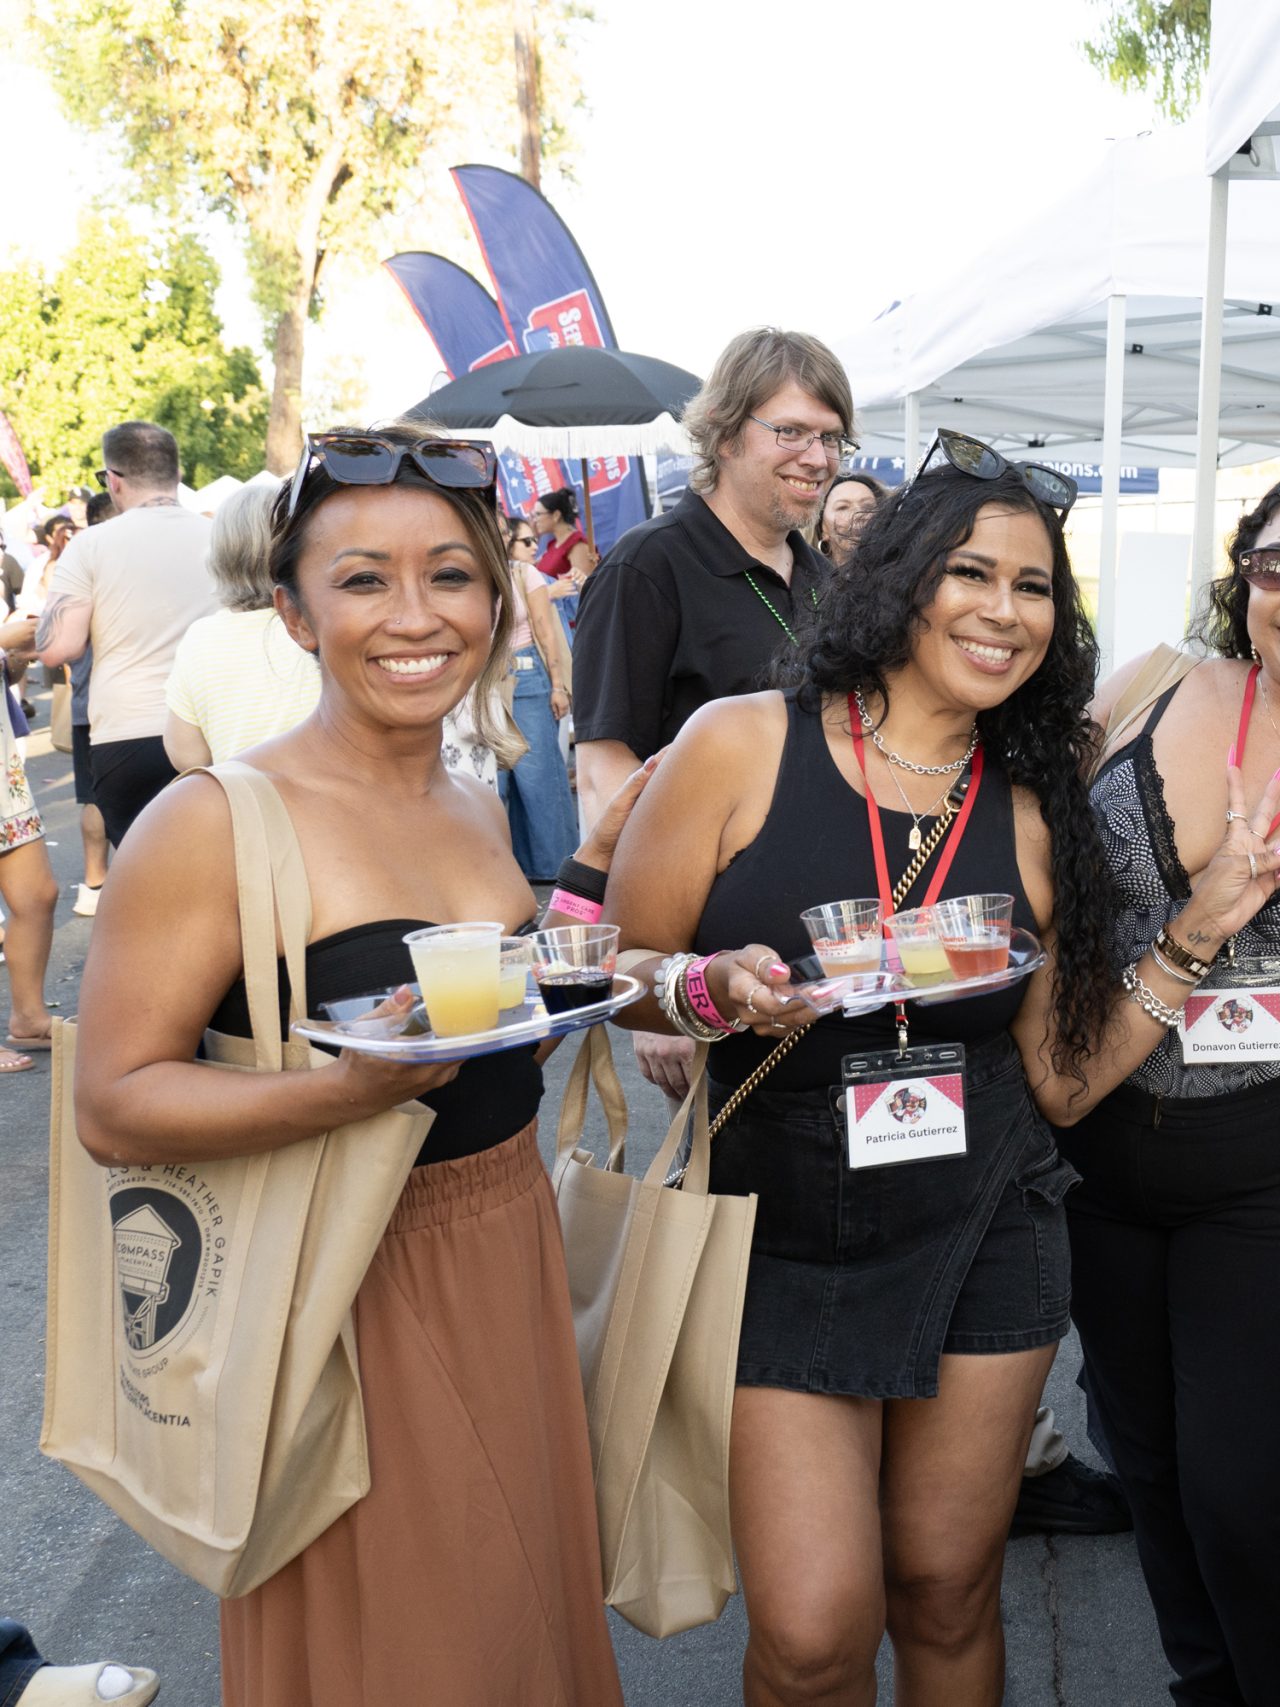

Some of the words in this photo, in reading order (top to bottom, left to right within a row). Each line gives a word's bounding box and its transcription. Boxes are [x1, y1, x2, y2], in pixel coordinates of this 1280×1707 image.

[1192, 1043, 1236, 1052] Donavon
[866, 1128, 906, 1145] Patricia
[908, 1125, 958, 1139] Gutierrez
[163, 1163, 223, 1227] HEATHER
[205, 1236, 226, 1297] GAPIK
[116, 1242, 166, 1262] COMPASS
